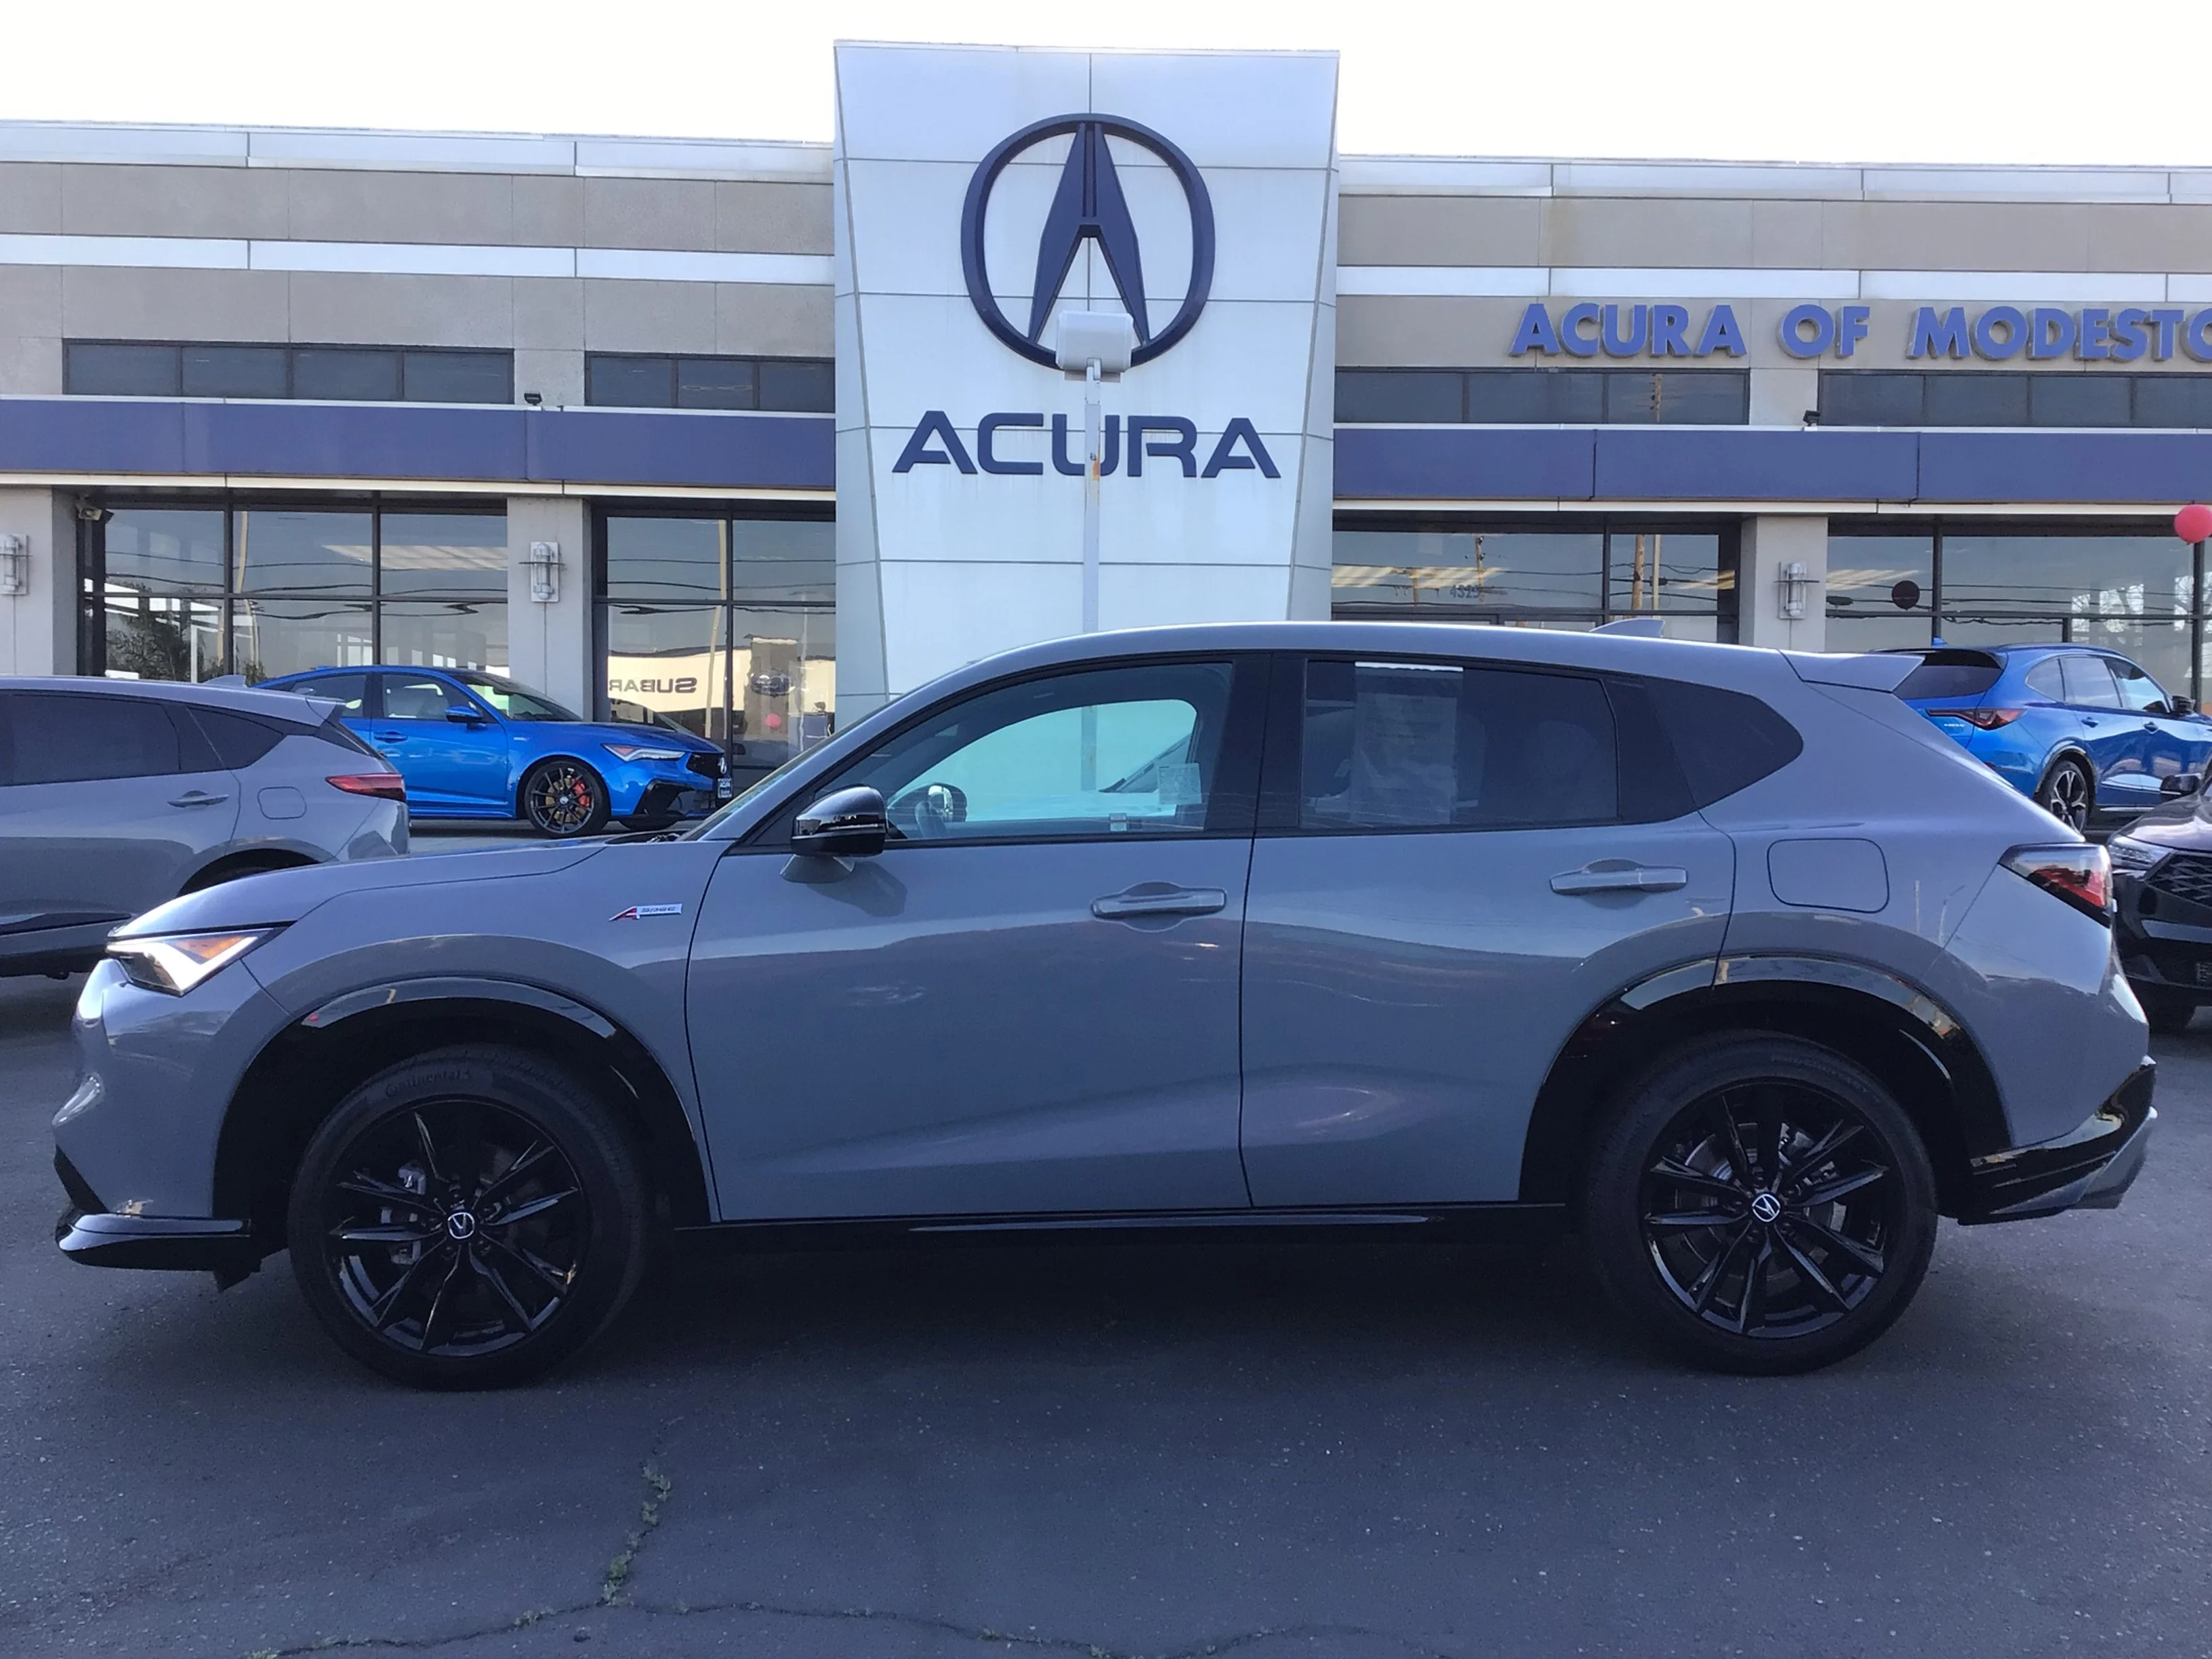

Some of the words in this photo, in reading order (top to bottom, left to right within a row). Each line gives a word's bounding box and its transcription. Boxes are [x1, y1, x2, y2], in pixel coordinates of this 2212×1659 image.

[1510, 303, 1746, 357] ACURA
[1779, 304, 1870, 359] OF
[892, 411, 1281, 478] ACURA
